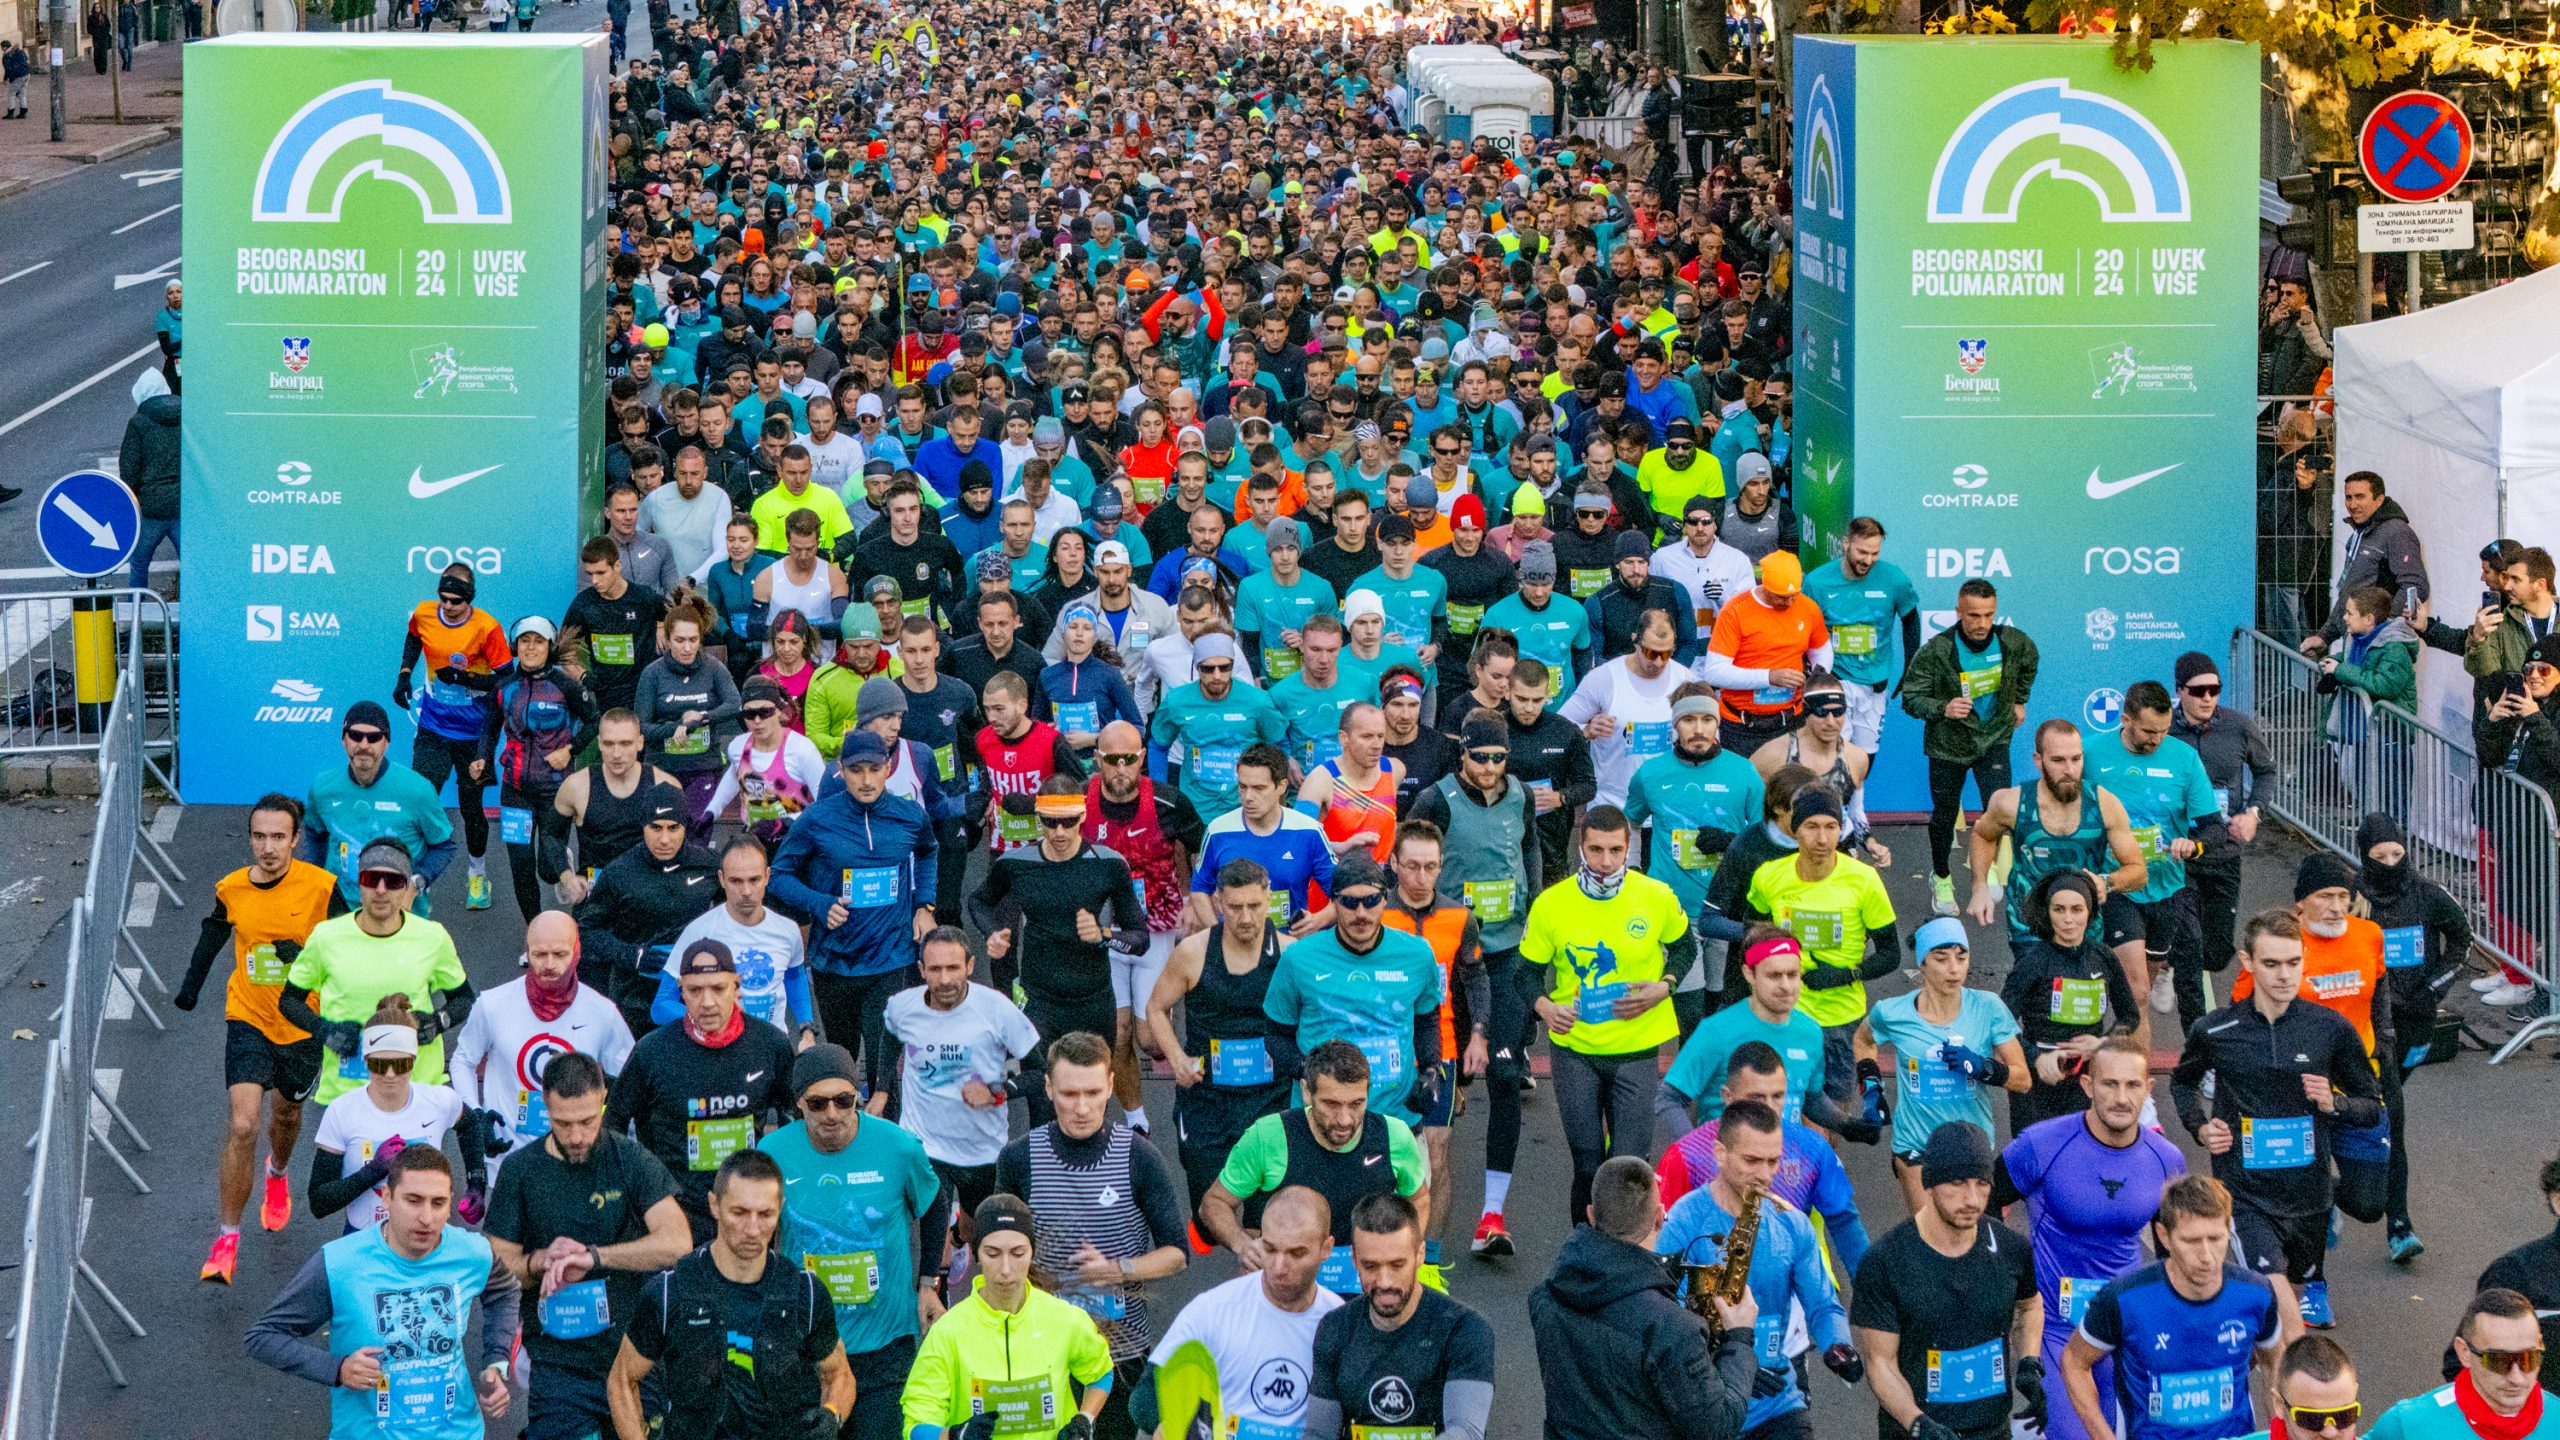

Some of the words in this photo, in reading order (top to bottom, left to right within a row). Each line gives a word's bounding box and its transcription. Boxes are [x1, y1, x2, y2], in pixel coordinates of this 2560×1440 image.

[2387, 209, 2421, 217] СНИМАЊА
[2422, 208, 2463, 216] ПАРКИРАЊА
[2376, 219, 2417, 227] КОМУНАЛНА
[2417, 217, 2455, 226] МИЛИЦИЈА
[237, 248, 365, 272] BEOGRADSKI
[415, 249, 446, 273] 20
[473, 250, 527, 273] UVEK
[1912, 249, 2043, 272] BEOGRADSKI
[2094, 249, 2124, 272] 20
[2152, 248, 2206, 271] UVEK
[237, 273, 387, 296] POLUMARATON
[415, 274, 446, 297] 24
[473, 272, 519, 297] VIŠE
[1912, 273, 2064, 296] POLUMARATON
[2094, 272, 2124, 296] 24
[2152, 270, 2198, 296] VIŠE
[269, 371, 324, 392] Београд
[458, 374, 515, 382] МИНИСТАРСТВО
[458, 381, 486, 389] СПОРТА
[1945, 374, 2000, 394] Београд
[2136, 381, 2164, 389] СПОРТА
[247, 490, 342, 504] COMTRADE
[1922, 494, 2018, 507] COMTRADE
[407, 545, 502, 575] rosa
[2085, 546, 2180, 575] rosa
[288, 612, 340, 629] SAVA
[2126, 612, 2154, 620] БАНКА
[2125, 621, 2179, 630] ПОШТАНСКА
[2125, 631, 2186, 640] ШТЕДИОНИЦА
[254, 706, 334, 722] ПОШТА
[940, 1044, 960, 1052] SNF
[940, 1053, 963, 1061] RUN
[710, 1095, 749, 1110] neo
[711, 1139, 736, 1149] VIKTOR
[1322, 1264, 1343, 1273] ALAN
[829, 1273, 854, 1283] REŠAD
[1964, 1368, 1974, 1383] 9
[403, 1393, 434, 1405] STEFAN
[998, 1401, 1030, 1412] JOVANA
